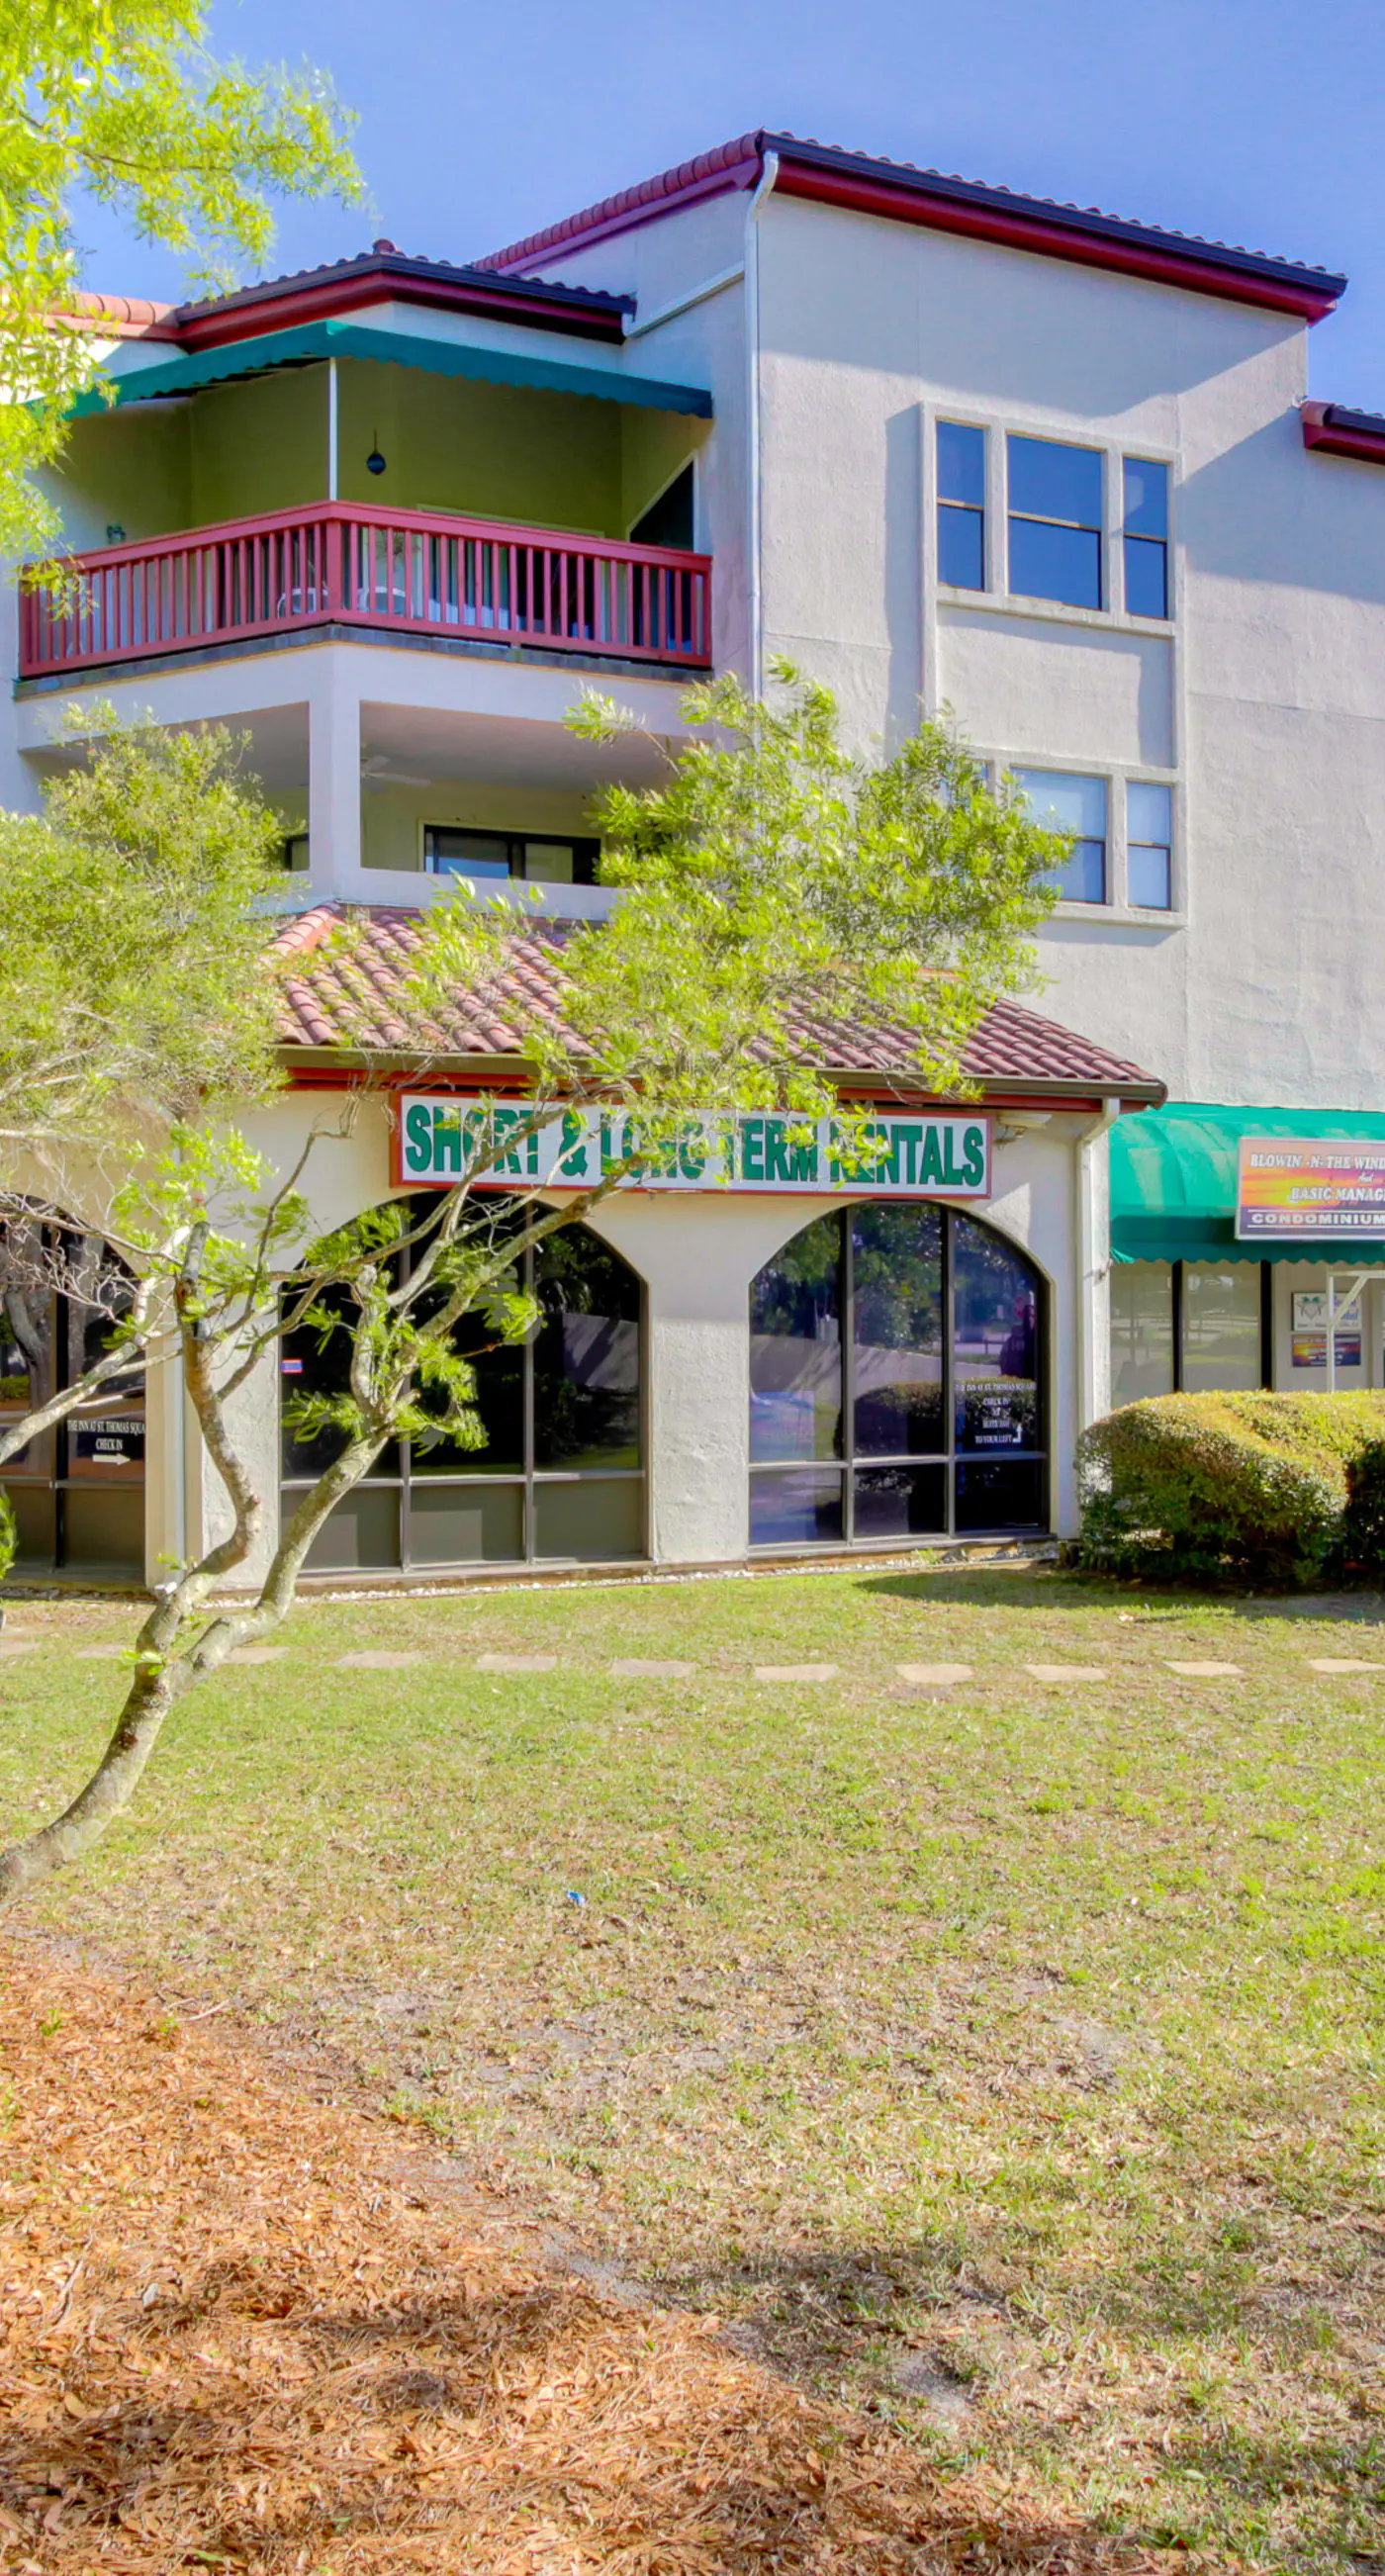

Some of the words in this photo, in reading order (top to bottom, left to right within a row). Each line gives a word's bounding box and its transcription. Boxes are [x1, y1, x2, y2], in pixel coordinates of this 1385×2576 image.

[559, 1109, 589, 1178] &
[599, 1113, 706, 1181] LOG
[1250, 1154, 1303, 1167] BLOWIN
[1326, 1155, 1352, 1169] THE
[1288, 1187, 1334, 1203] BASIC
[1335, 1187, 1385, 1202] MANAG
[78, 1420, 89, 1432] INN
[90, 1421, 97, 1432] AT
[106, 1421, 130, 1433] THOMAS
[95, 1437, 116, 1451] CHECK
[116, 1438, 123, 1450] IN
